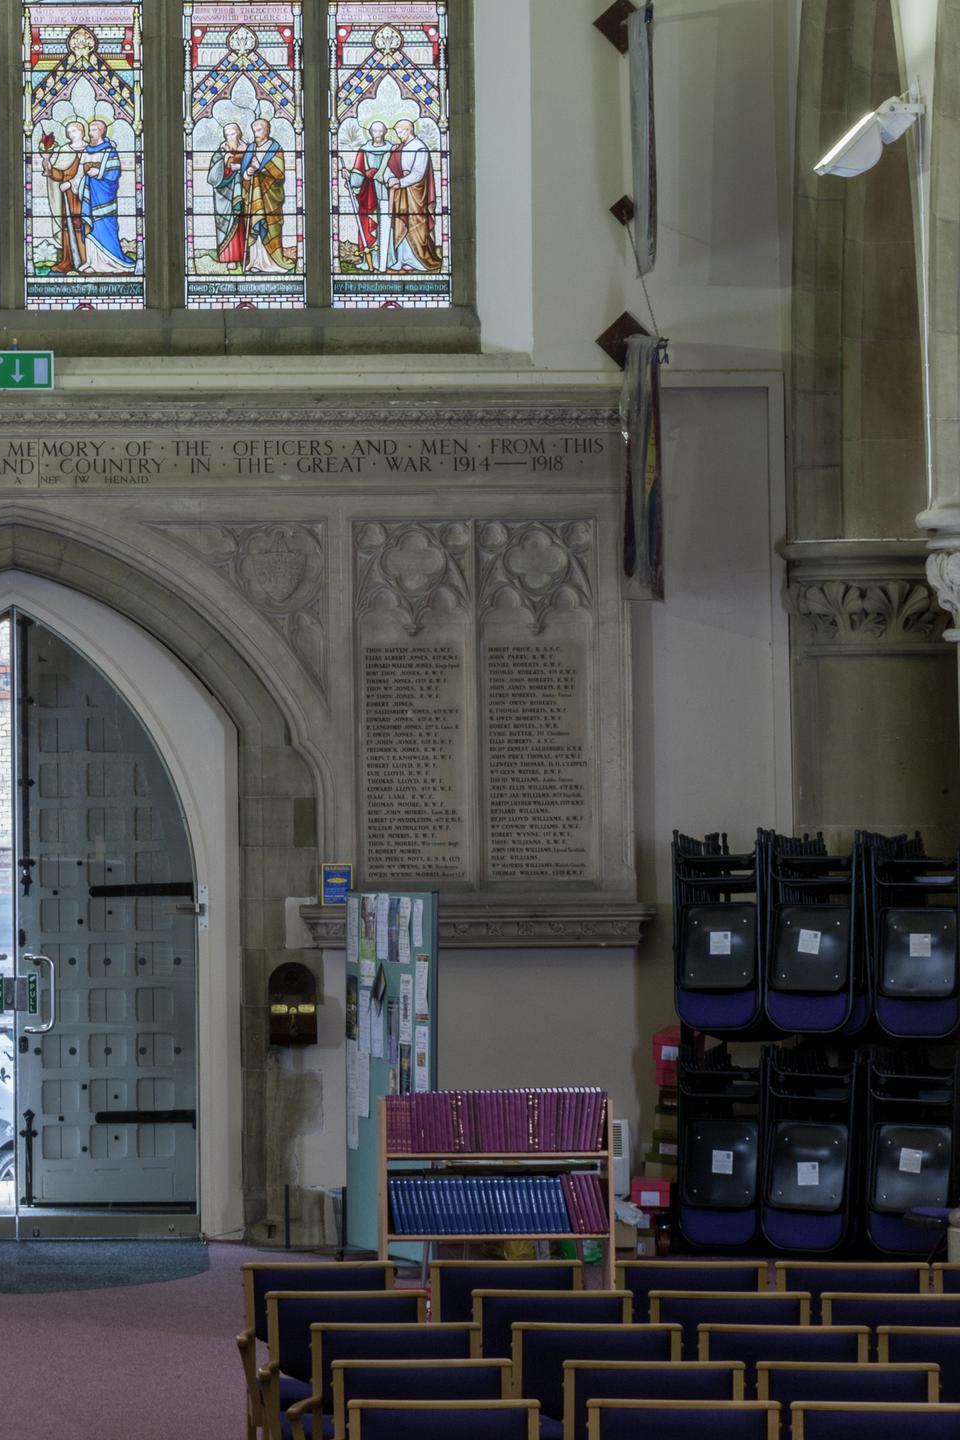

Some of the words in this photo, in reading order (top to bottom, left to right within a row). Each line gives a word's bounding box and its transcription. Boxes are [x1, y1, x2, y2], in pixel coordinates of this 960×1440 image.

[7, 442, 106, 457] MEMORY
[125, 441, 153, 456] OF
[171, 441, 212, 456] THE
[233, 440, 333, 456] OFFICERS
[351, 440, 397, 455] AND
[421, 440, 469, 455] MEN
[490, 439, 545, 454] FROM
[561, 439, 604, 454] THIS
[59, 458, 165, 474] COUNTRY
[190, 458, 211, 473] IN
[235, 458, 274, 473] THE
[297, 457, 363, 472] GREAT
[384, 457, 431, 472] WAR
